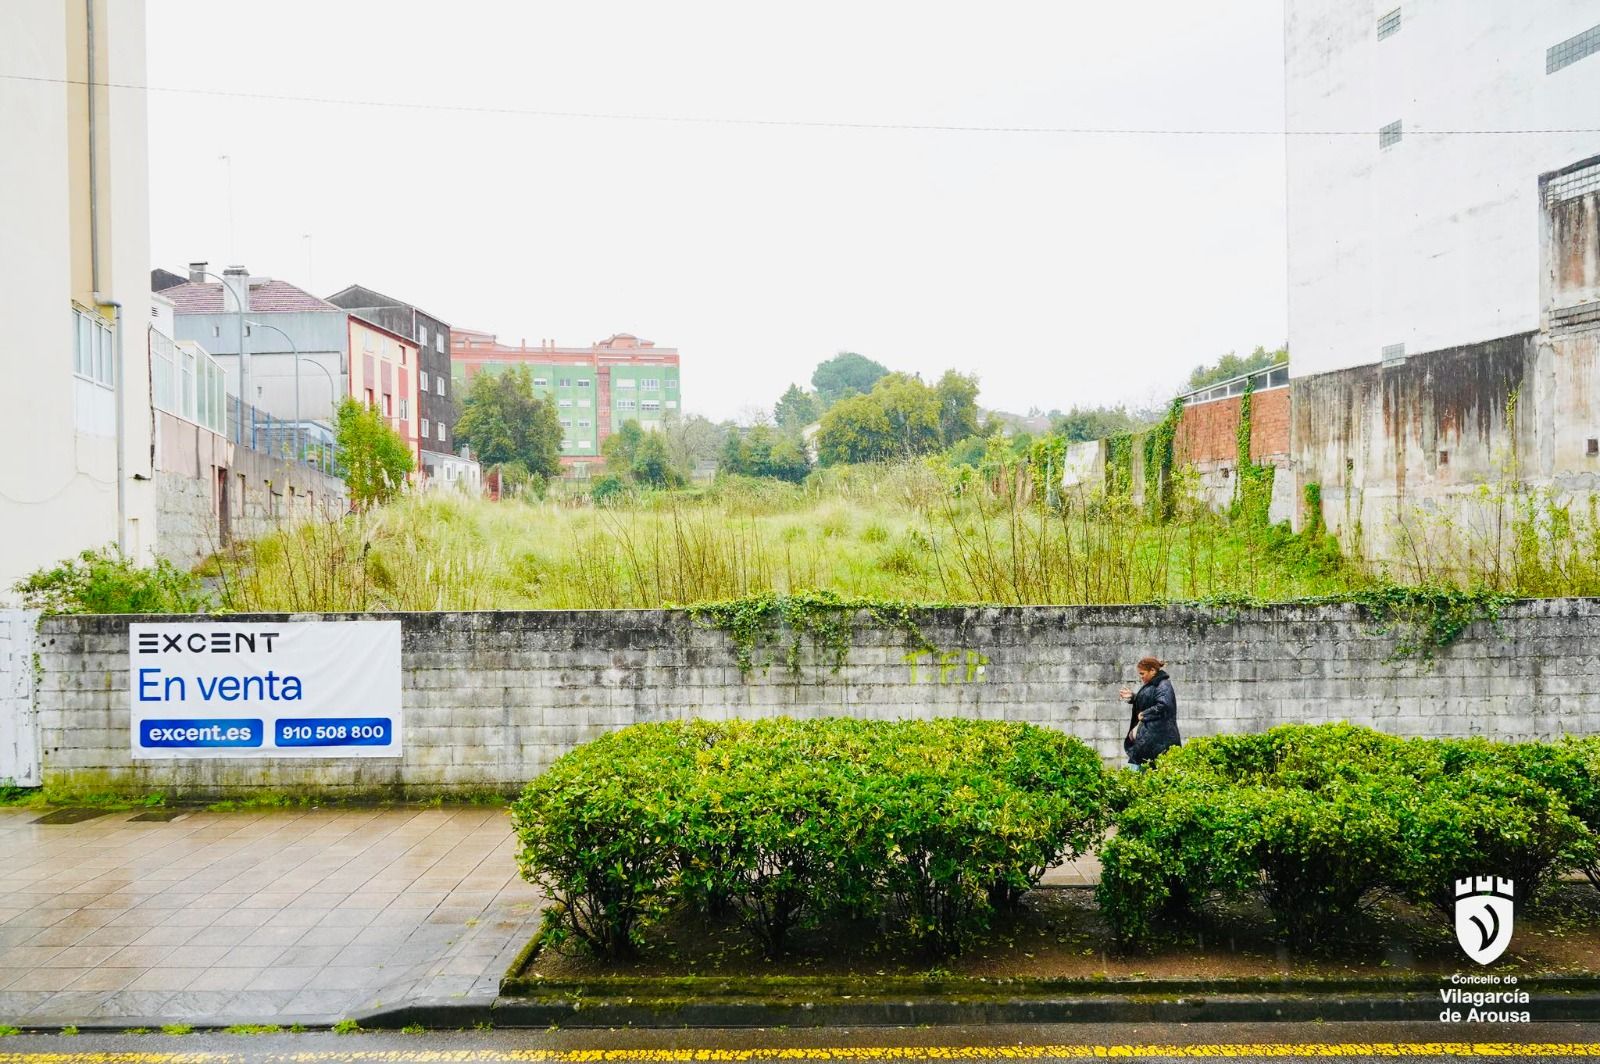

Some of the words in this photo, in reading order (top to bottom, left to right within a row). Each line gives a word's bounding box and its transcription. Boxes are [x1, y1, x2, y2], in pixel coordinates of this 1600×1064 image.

[138, 632, 280, 654] EXCENT
[139, 668, 185, 701] En
[197, 670, 302, 701] venta
[149, 725, 252, 741] excent.es
[282, 726, 312, 740] 910
[315, 726, 347, 739] 508
[351, 725, 384, 739] 800
